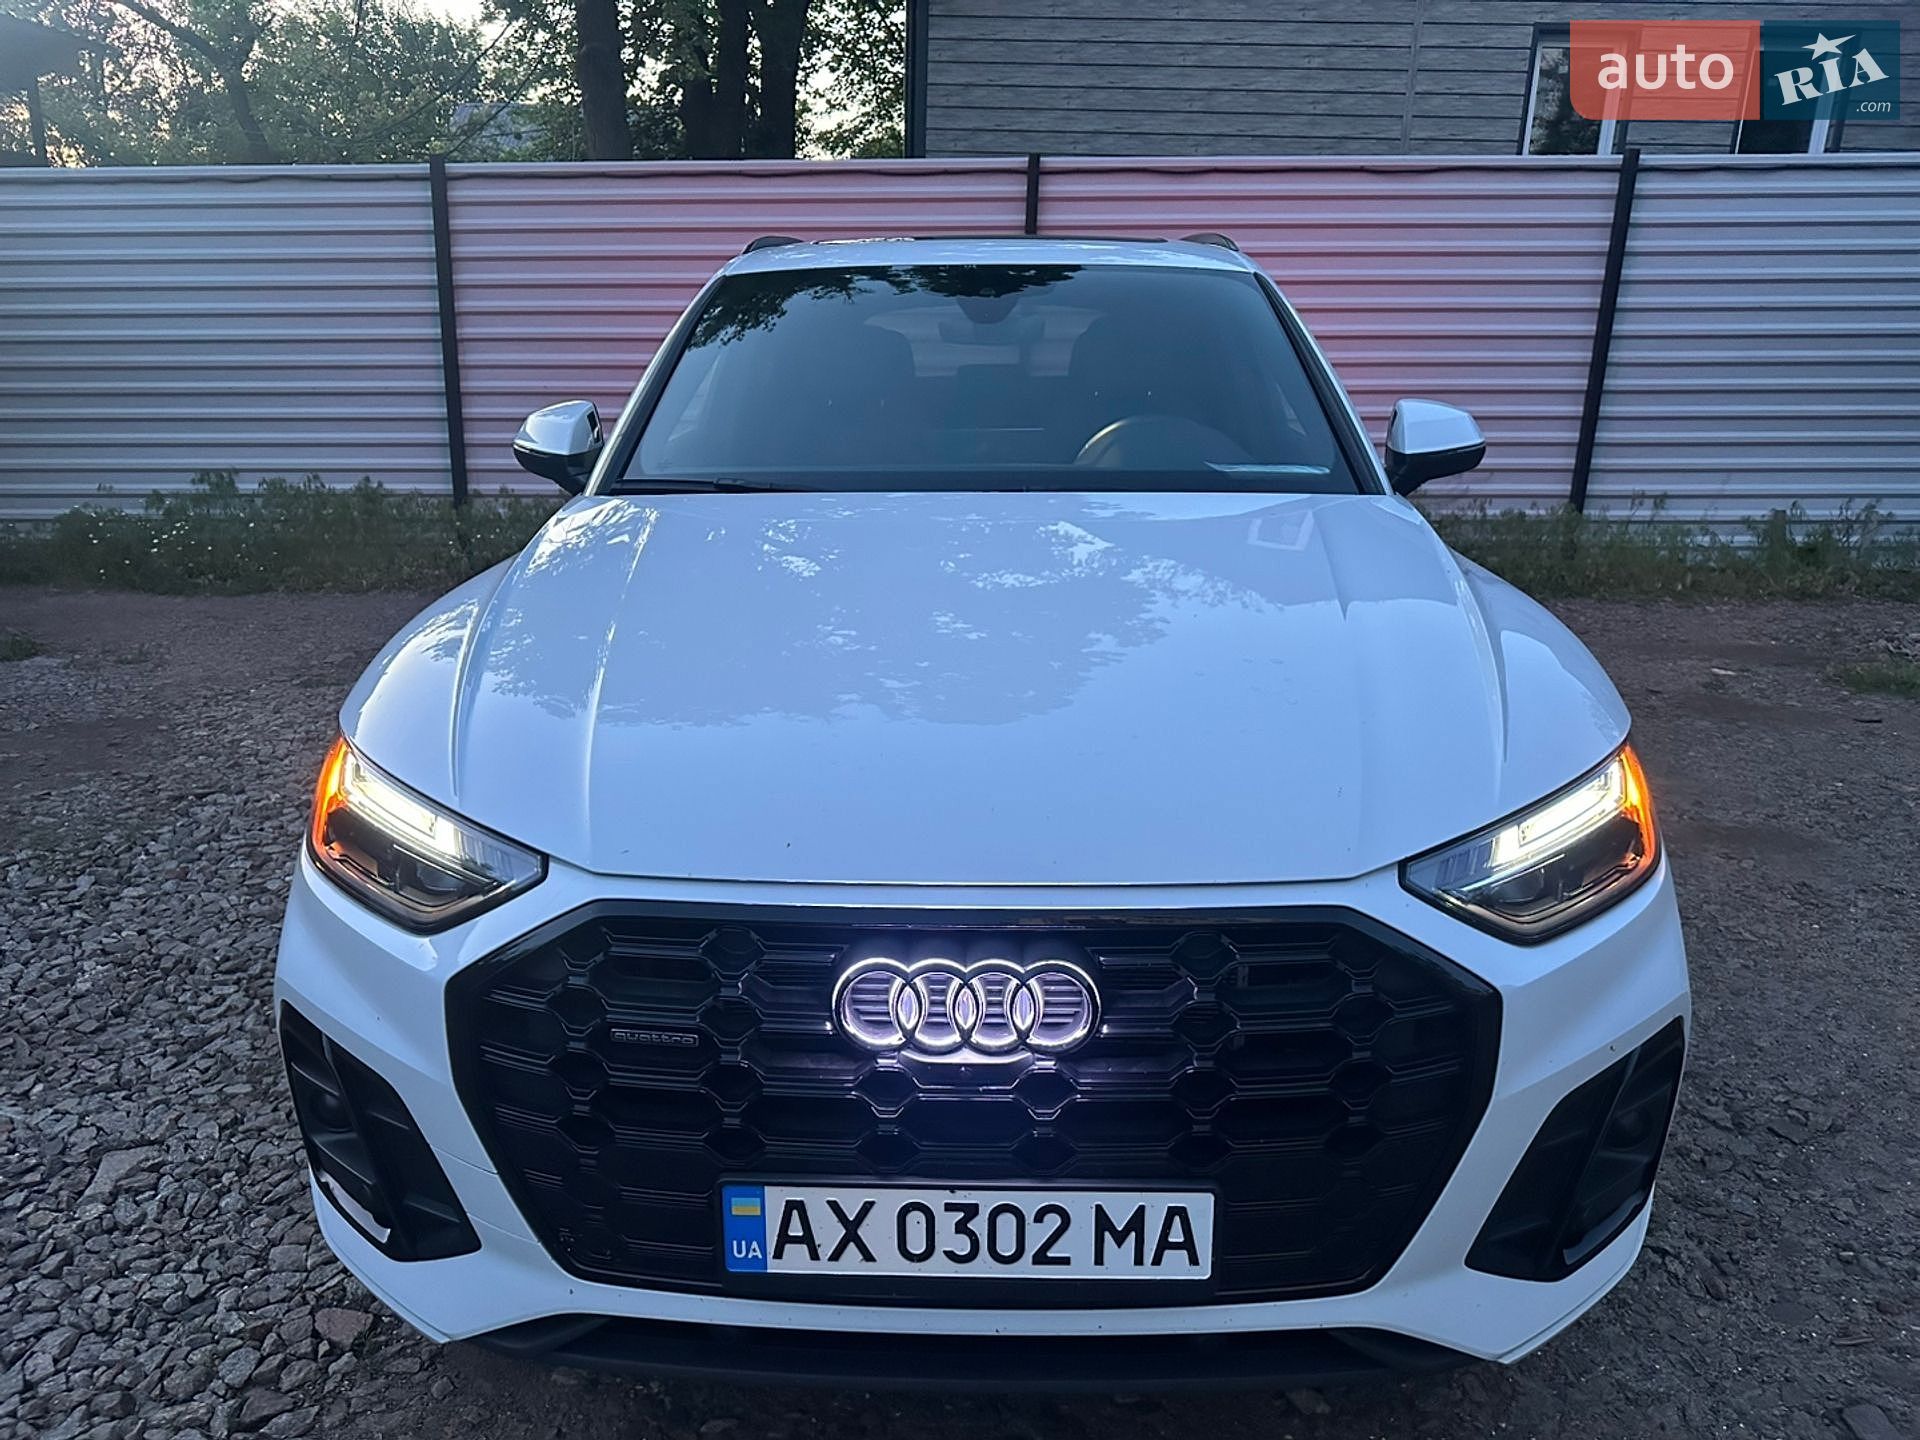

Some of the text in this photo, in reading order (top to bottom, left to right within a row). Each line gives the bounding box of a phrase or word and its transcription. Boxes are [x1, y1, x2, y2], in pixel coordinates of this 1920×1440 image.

[732, 1240, 762, 1259] UA
[772, 1199, 1200, 1267] AX 0302 MA
